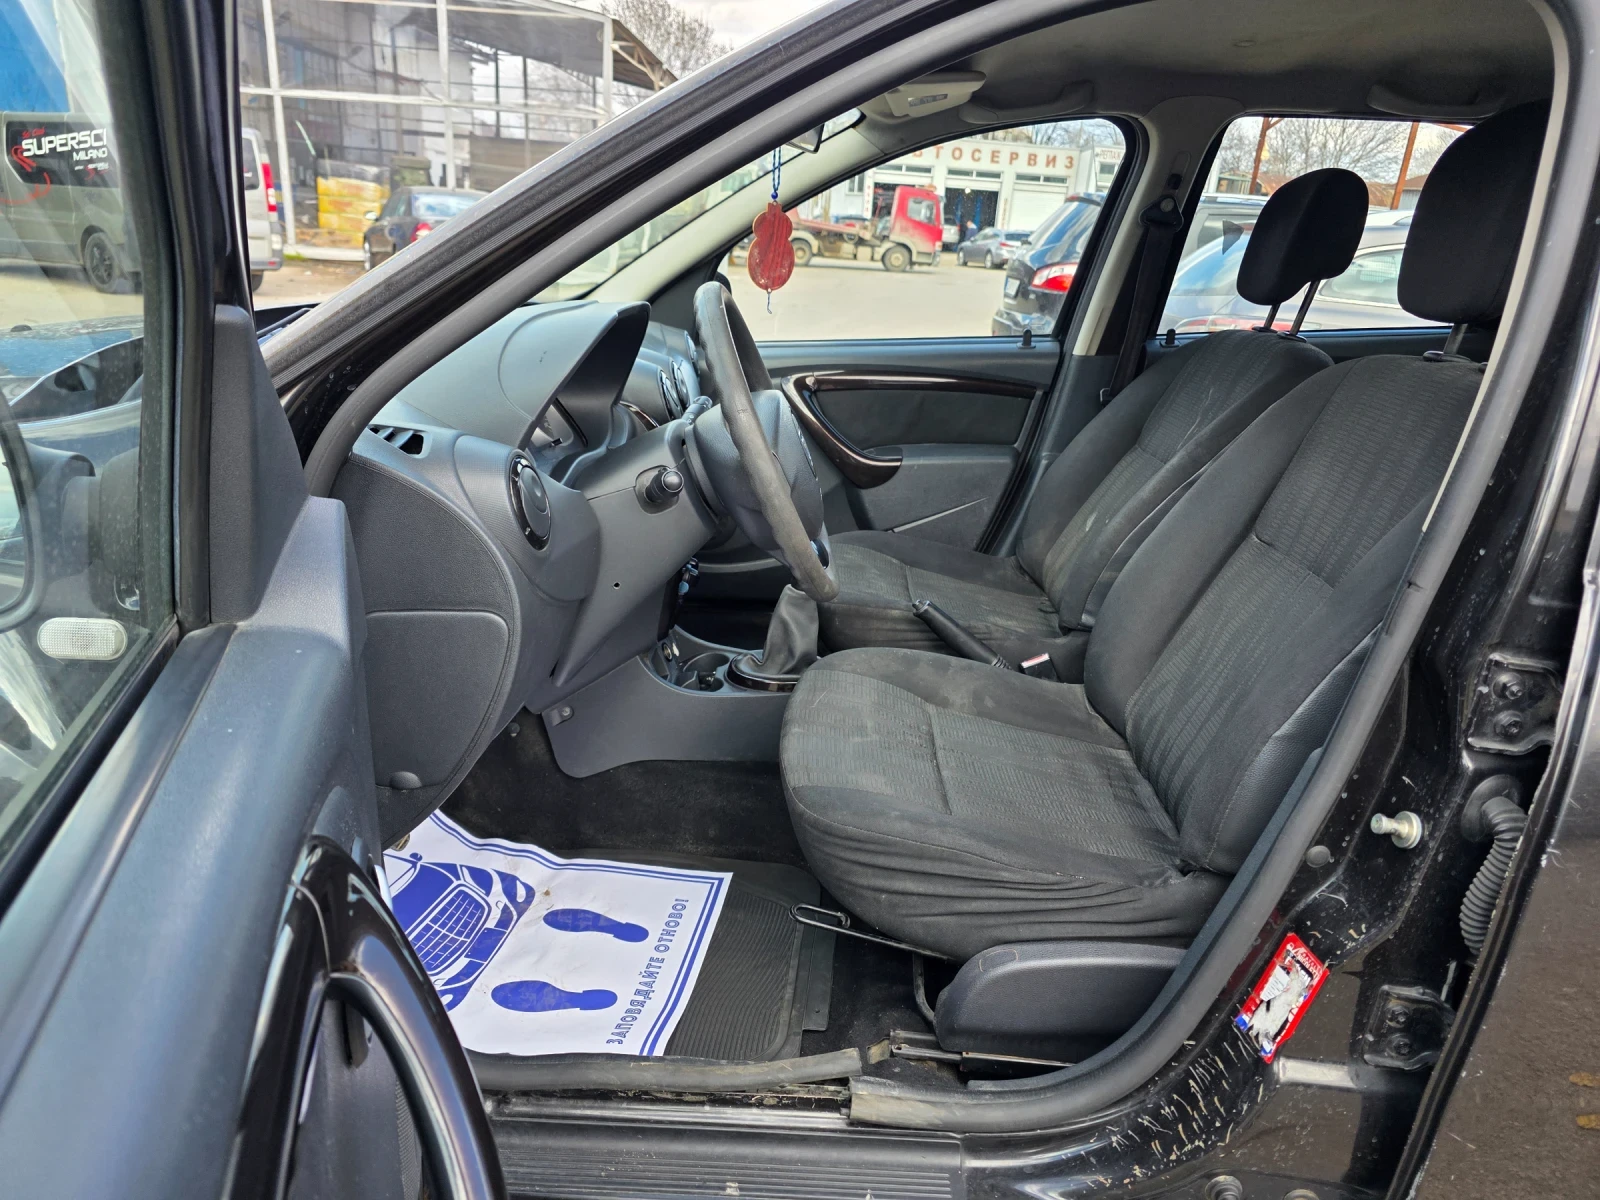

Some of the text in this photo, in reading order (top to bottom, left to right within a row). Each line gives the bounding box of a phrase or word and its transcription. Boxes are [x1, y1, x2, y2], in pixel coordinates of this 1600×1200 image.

[22, 128, 107, 157] SUPERSCI
[72, 147, 108, 161] MILANO
[606, 898, 689, 1045] ЗАПОВЯДАЙТЕ ОТНОВО!
